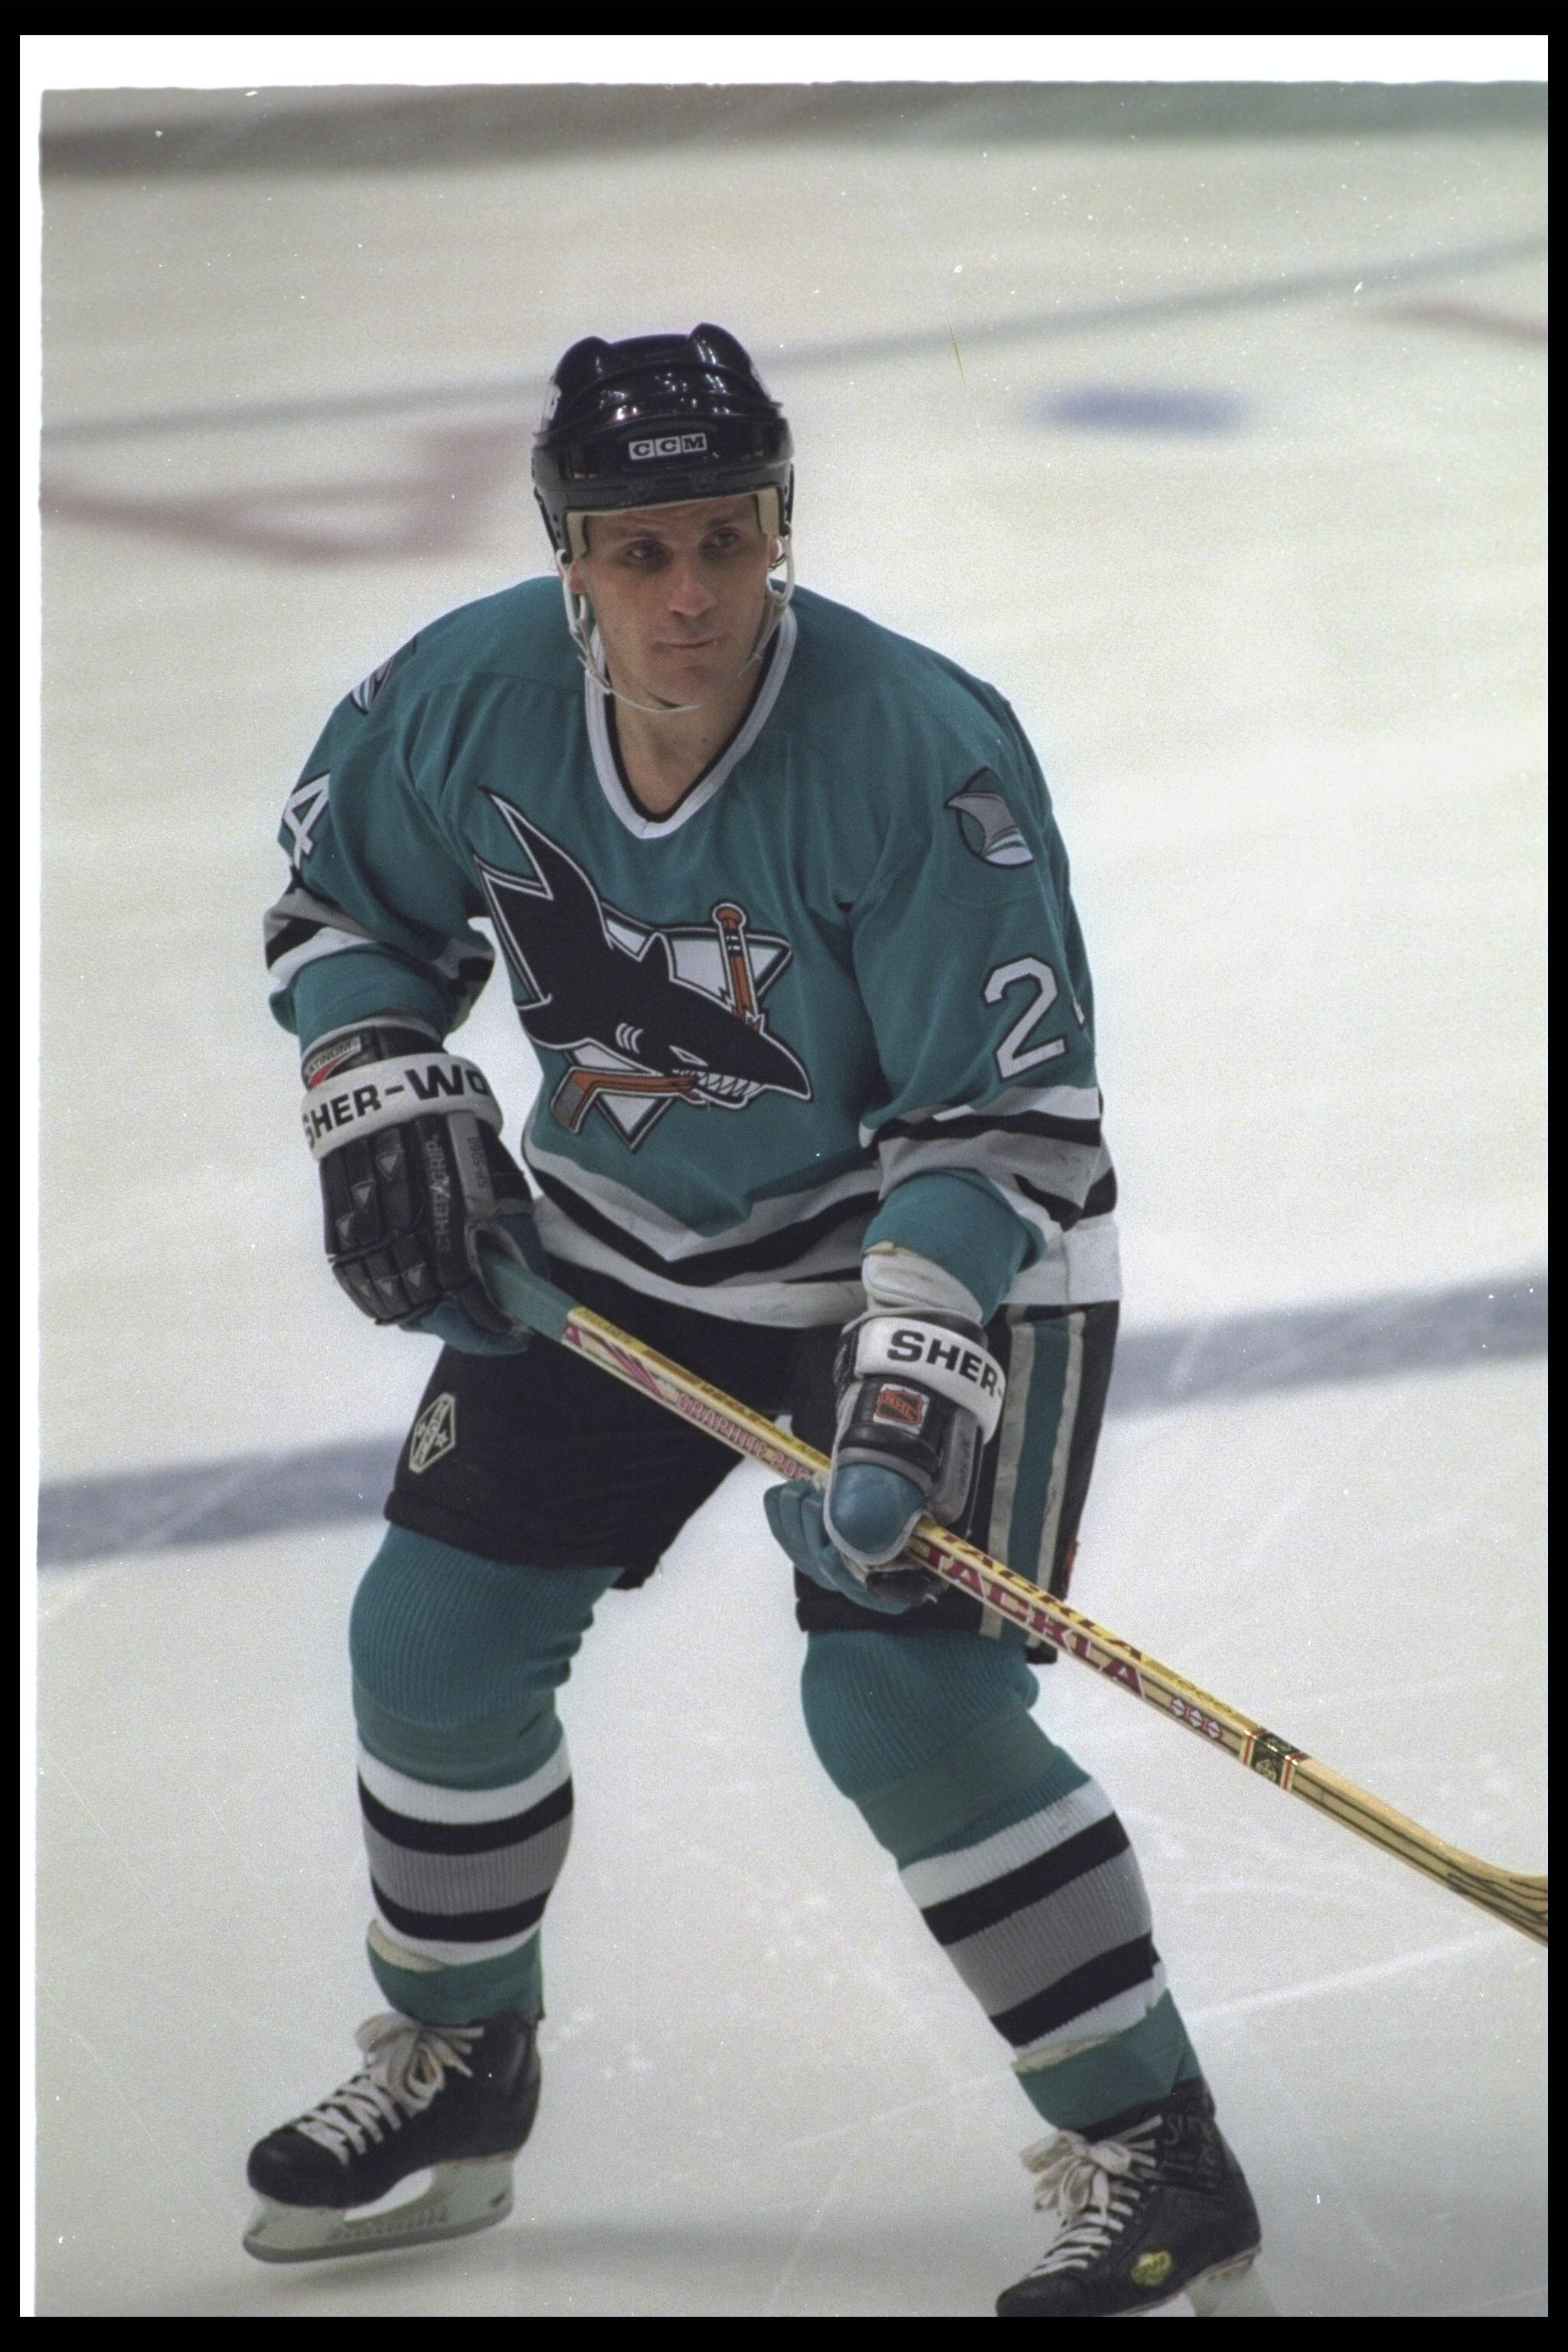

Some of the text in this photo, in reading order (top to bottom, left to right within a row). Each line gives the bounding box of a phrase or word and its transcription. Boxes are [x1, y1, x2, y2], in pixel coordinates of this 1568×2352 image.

[630, 435, 707, 459] CCM
[281, 769, 332, 871] 4
[981, 954, 1086, 1082] 2
[926, 1544, 1145, 1699] TACKLA
